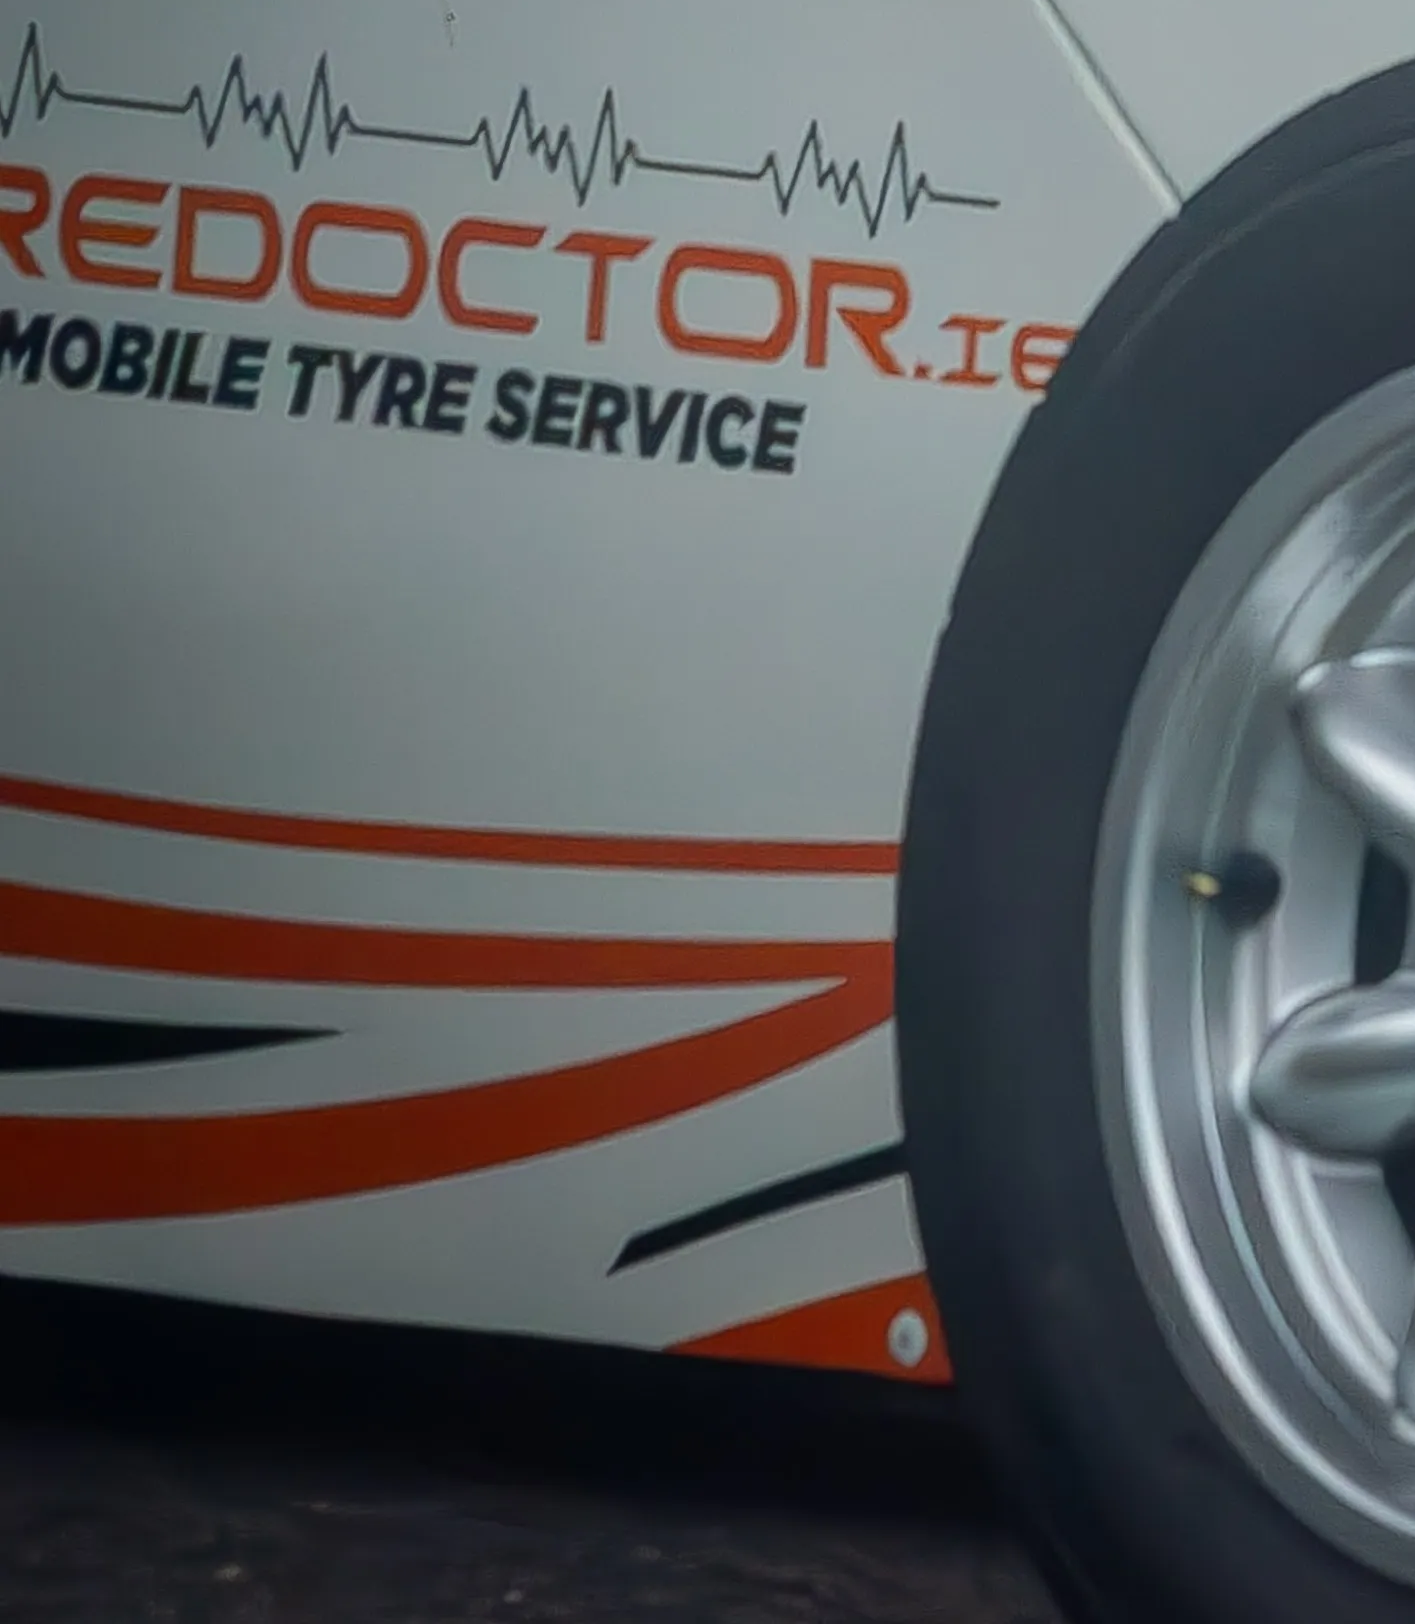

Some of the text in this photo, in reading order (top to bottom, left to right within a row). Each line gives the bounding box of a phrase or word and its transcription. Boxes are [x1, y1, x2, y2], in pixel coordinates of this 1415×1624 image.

[0, 308, 807, 475] MOBILE TYRE SERVICE
